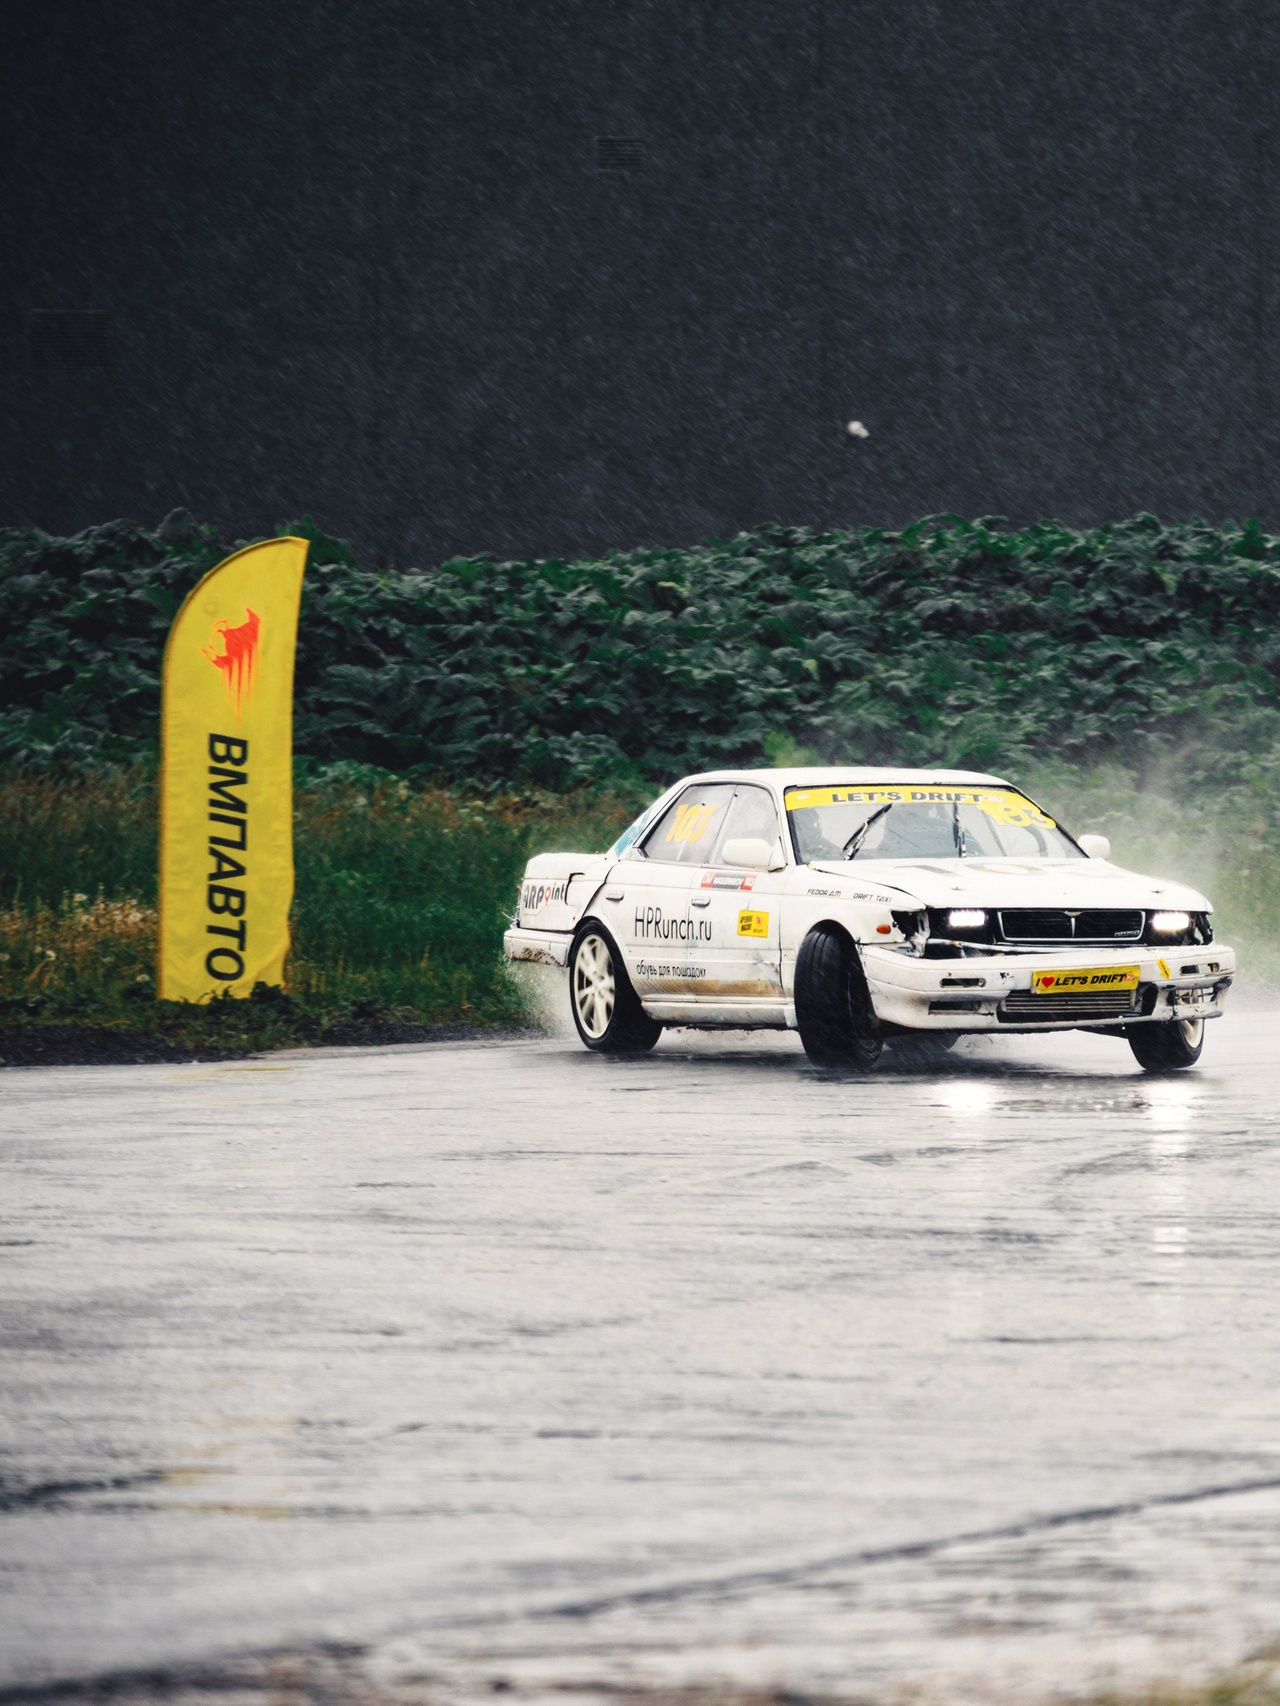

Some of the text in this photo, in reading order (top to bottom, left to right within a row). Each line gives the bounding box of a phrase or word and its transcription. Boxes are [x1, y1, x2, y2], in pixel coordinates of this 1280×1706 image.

[832, 791, 902, 803] LET'S
[911, 791, 983, 803] DRIFT
[665, 804, 717, 843] 103
[205, 733, 249, 981] ВМПАВТО
[876, 895, 893, 903] TAXI
[634, 906, 712, 941] HPRunch.ru
[636, 959, 658, 979] обувь
[658, 965, 671, 977] для
[1054, 975, 1087, 986] LET'S
